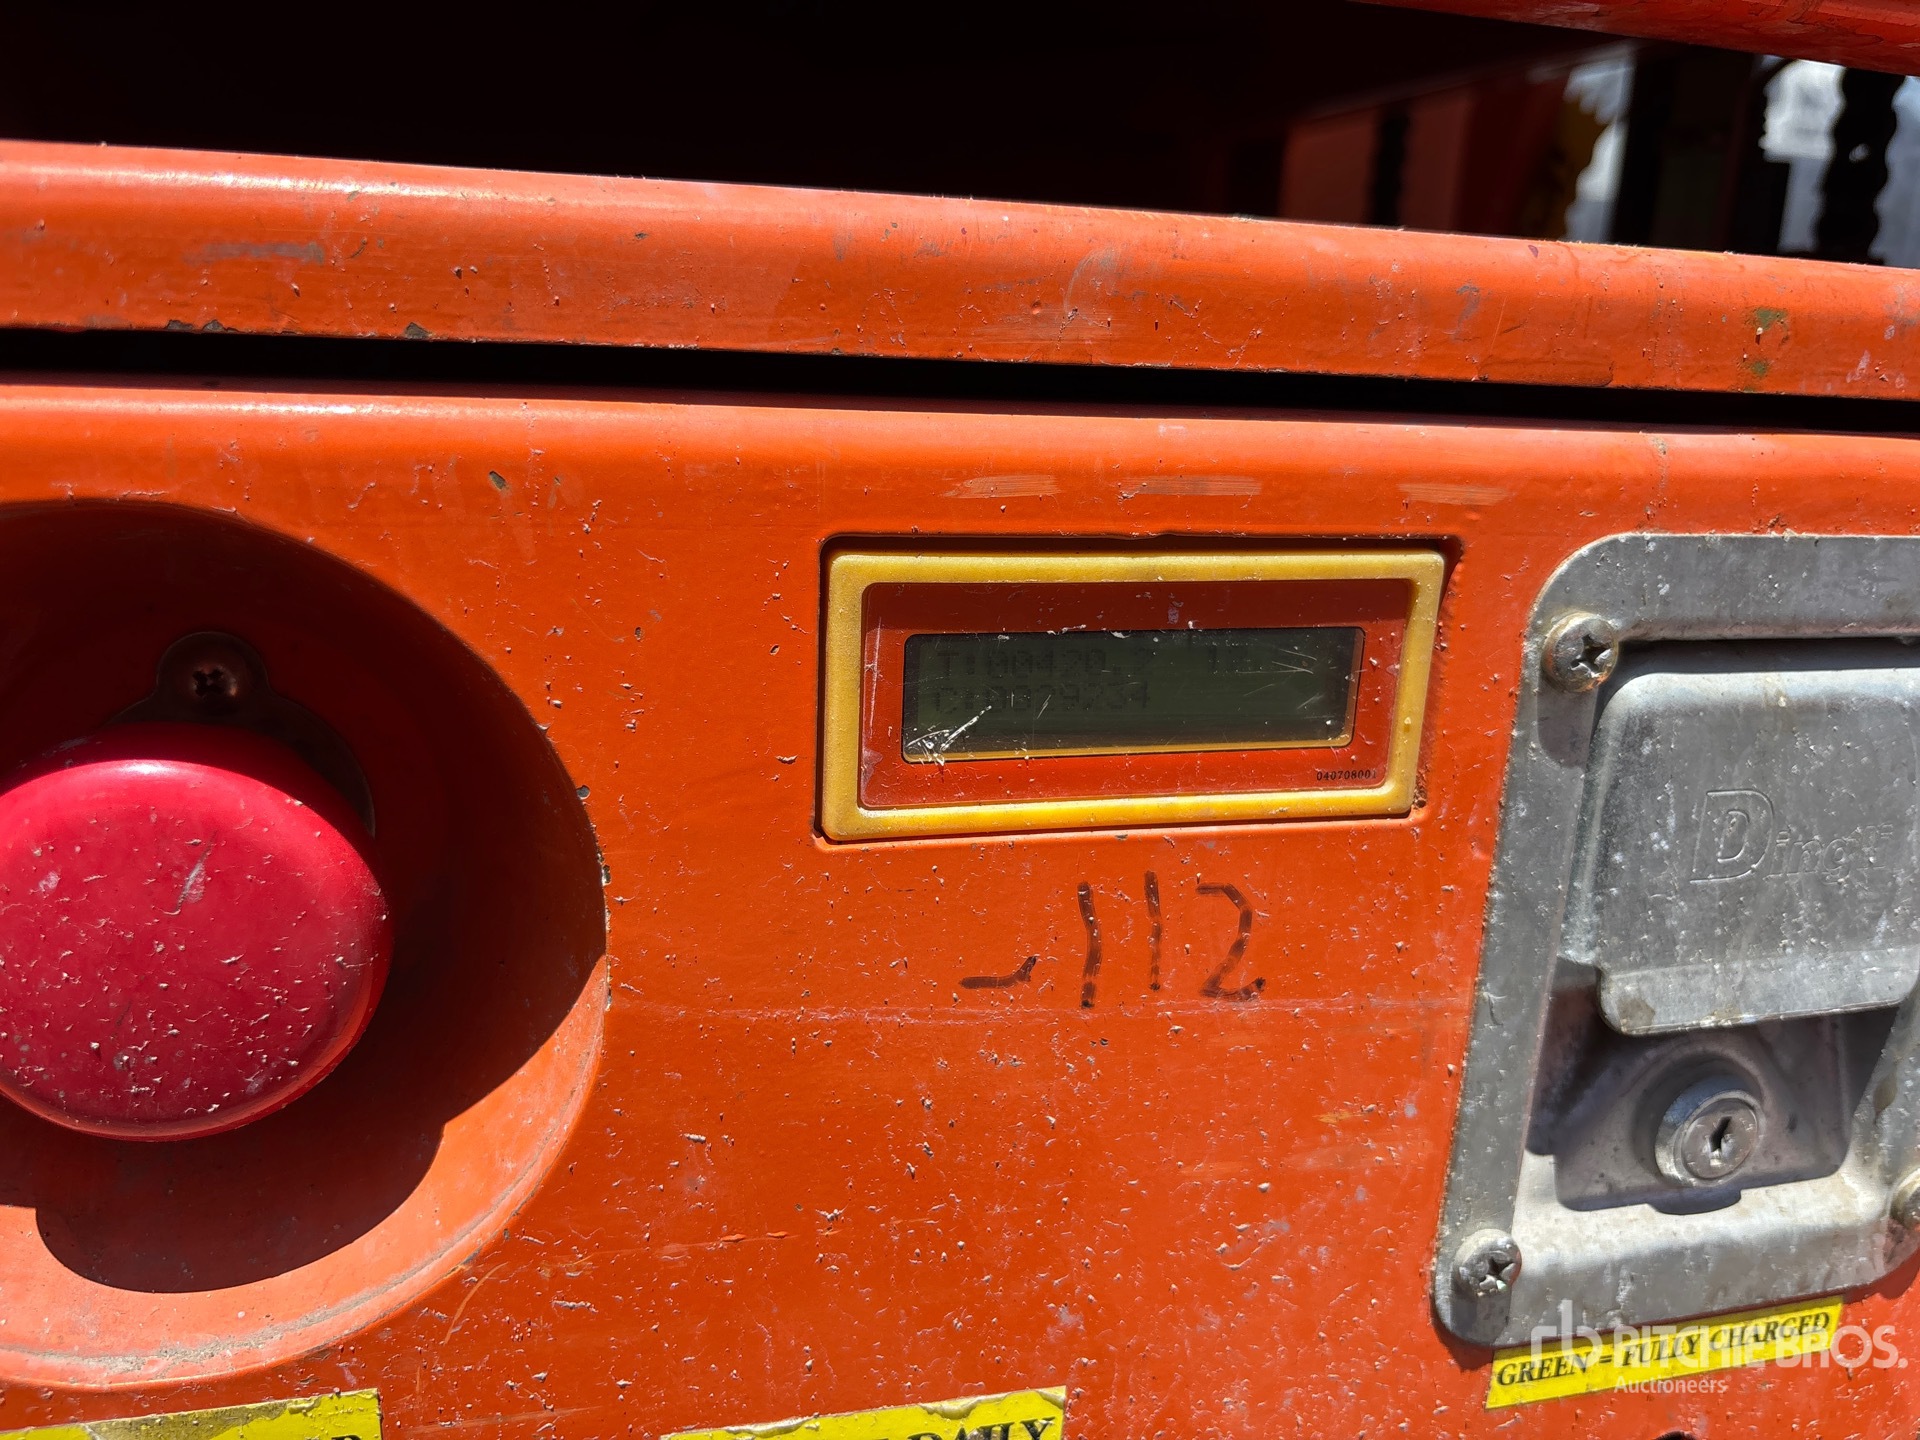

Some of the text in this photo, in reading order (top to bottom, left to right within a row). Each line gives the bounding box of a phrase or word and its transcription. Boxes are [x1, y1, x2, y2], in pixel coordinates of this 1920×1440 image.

[1316, 768, 1377, 781] 040708001
[1496, 1351, 1593, 1387] GREEN
[1621, 1333, 1701, 1368] FULLY
[1708, 1311, 1831, 1351] CHARGED
